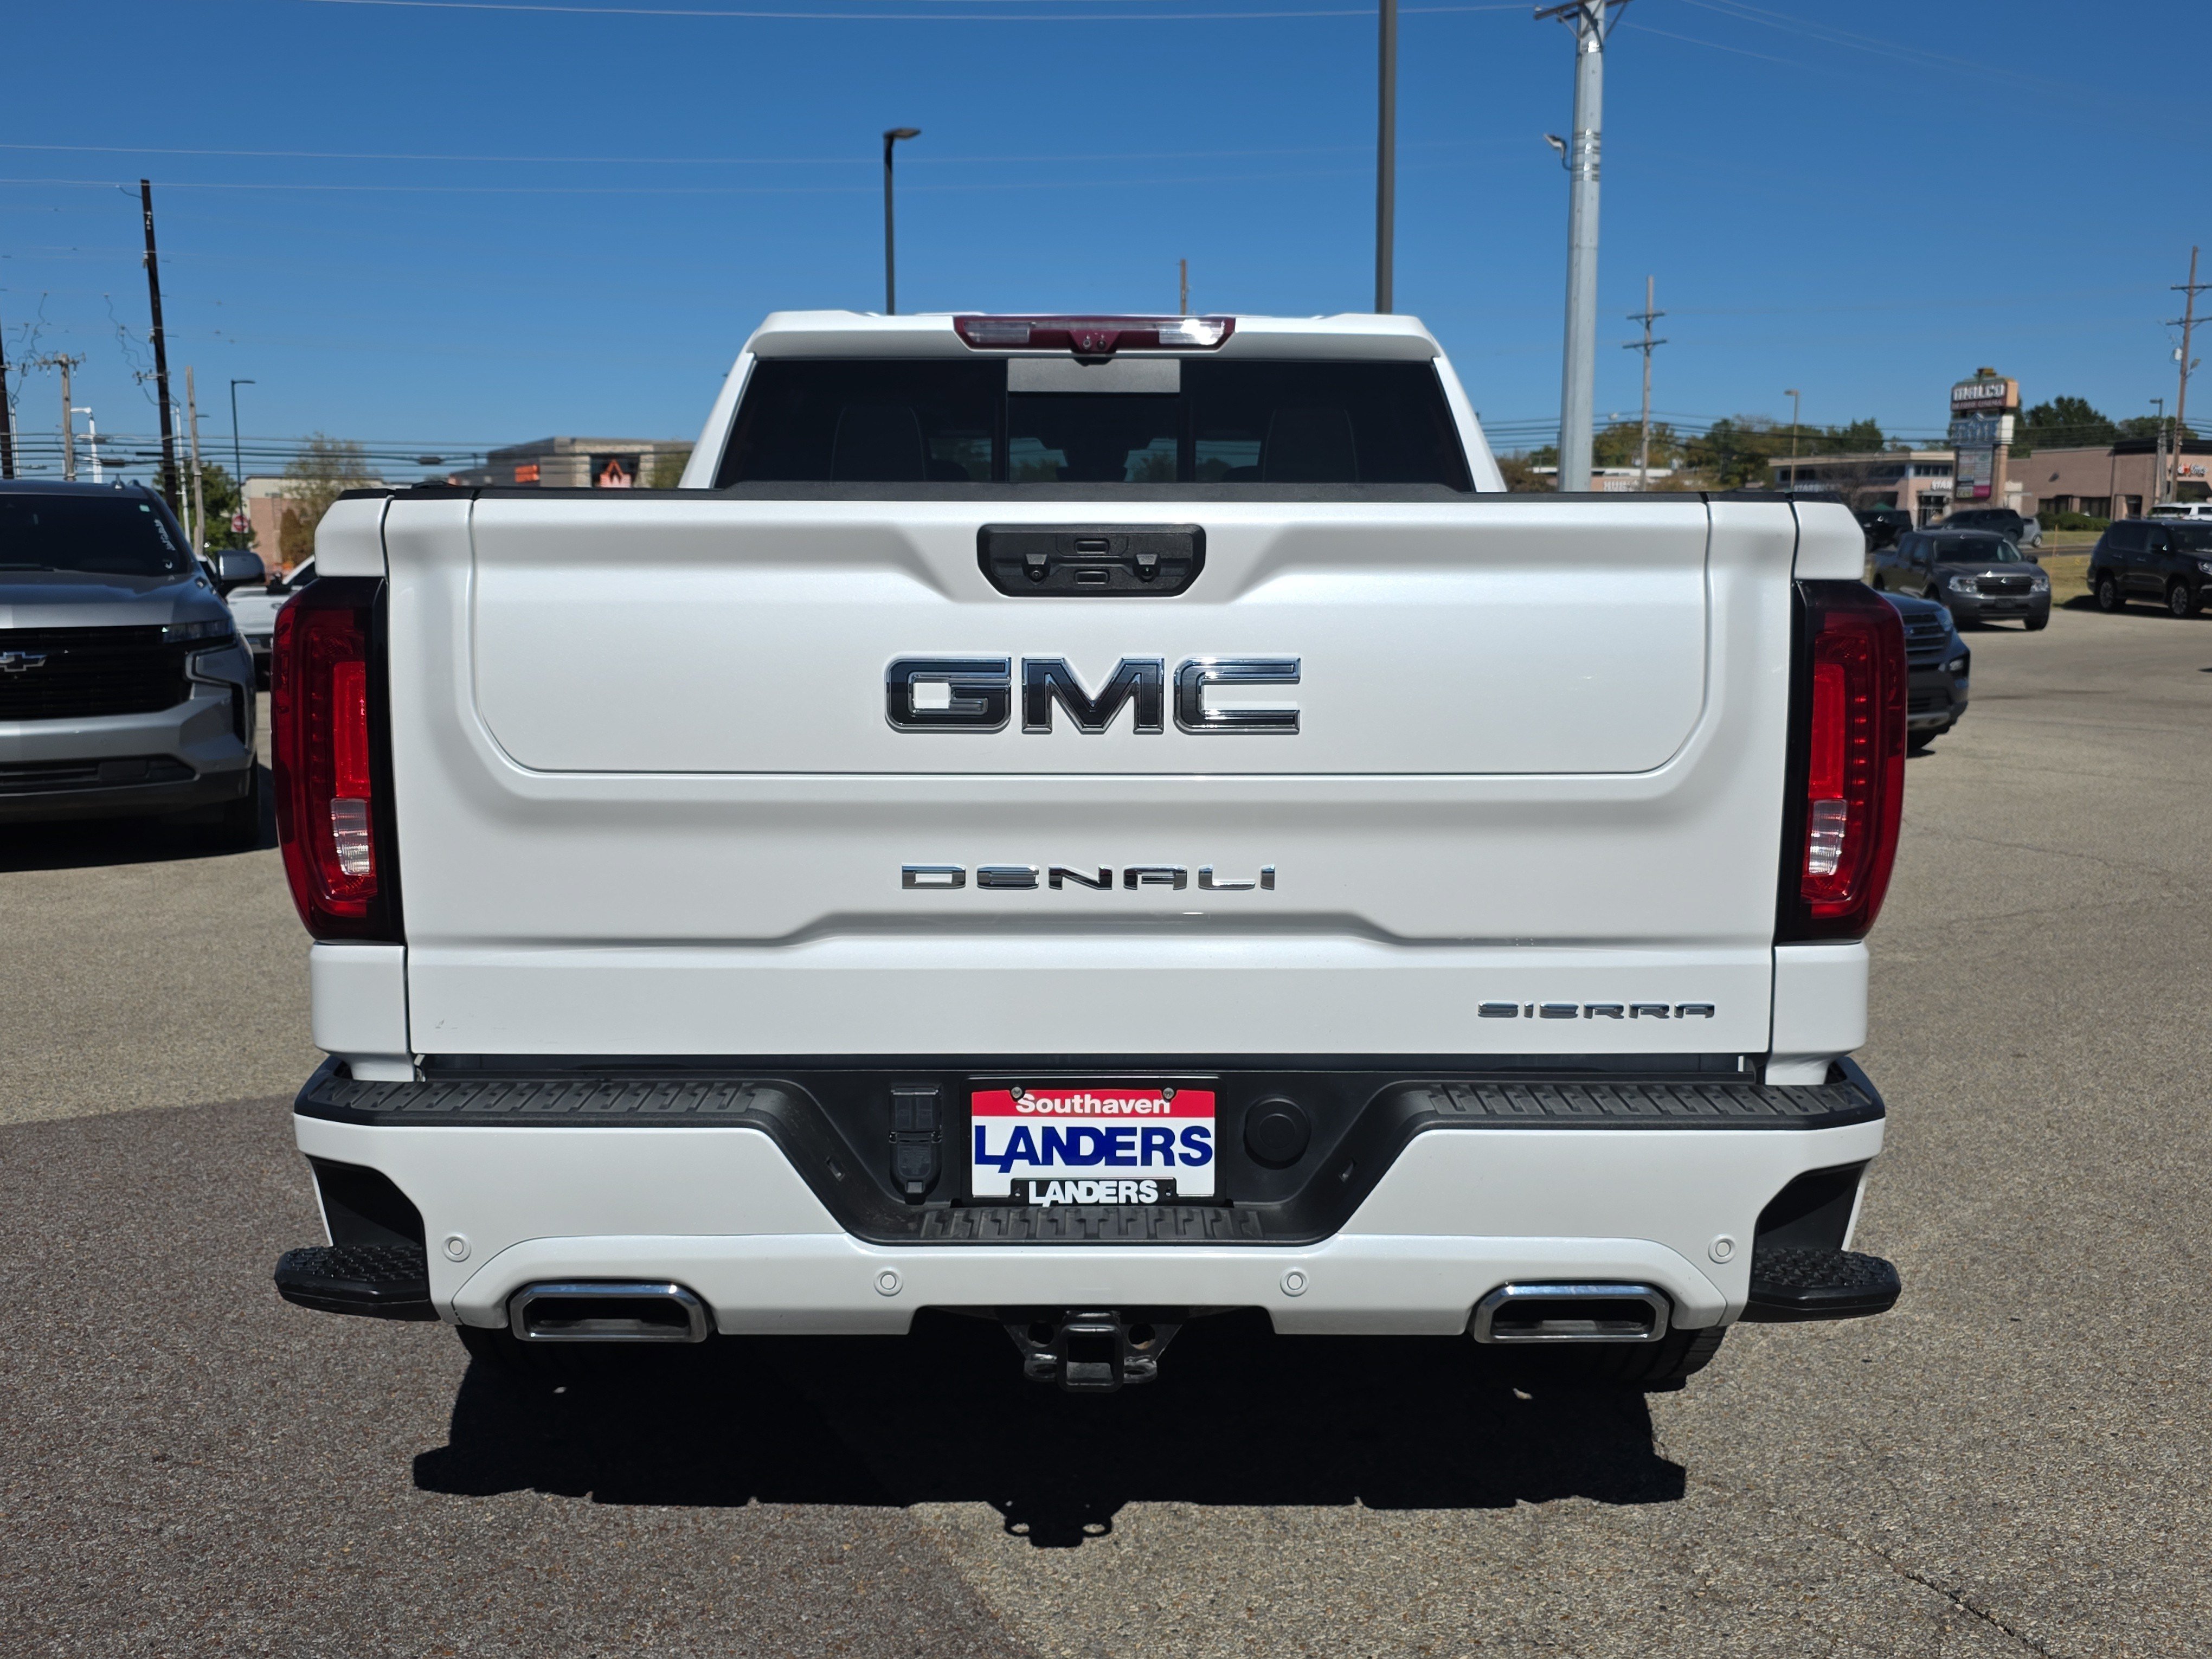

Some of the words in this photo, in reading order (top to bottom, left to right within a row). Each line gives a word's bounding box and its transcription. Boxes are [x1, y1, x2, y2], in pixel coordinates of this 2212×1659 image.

[885, 657, 1300, 735] GMC
[901, 864, 1275, 890] DENALI
[1477, 1001, 1715, 1019] SIERRA
[1015, 1094, 1171, 1114] Southaven
[974, 1124, 1213, 1173] LANDERS
[1029, 1180, 1158, 1207] LANDERS
